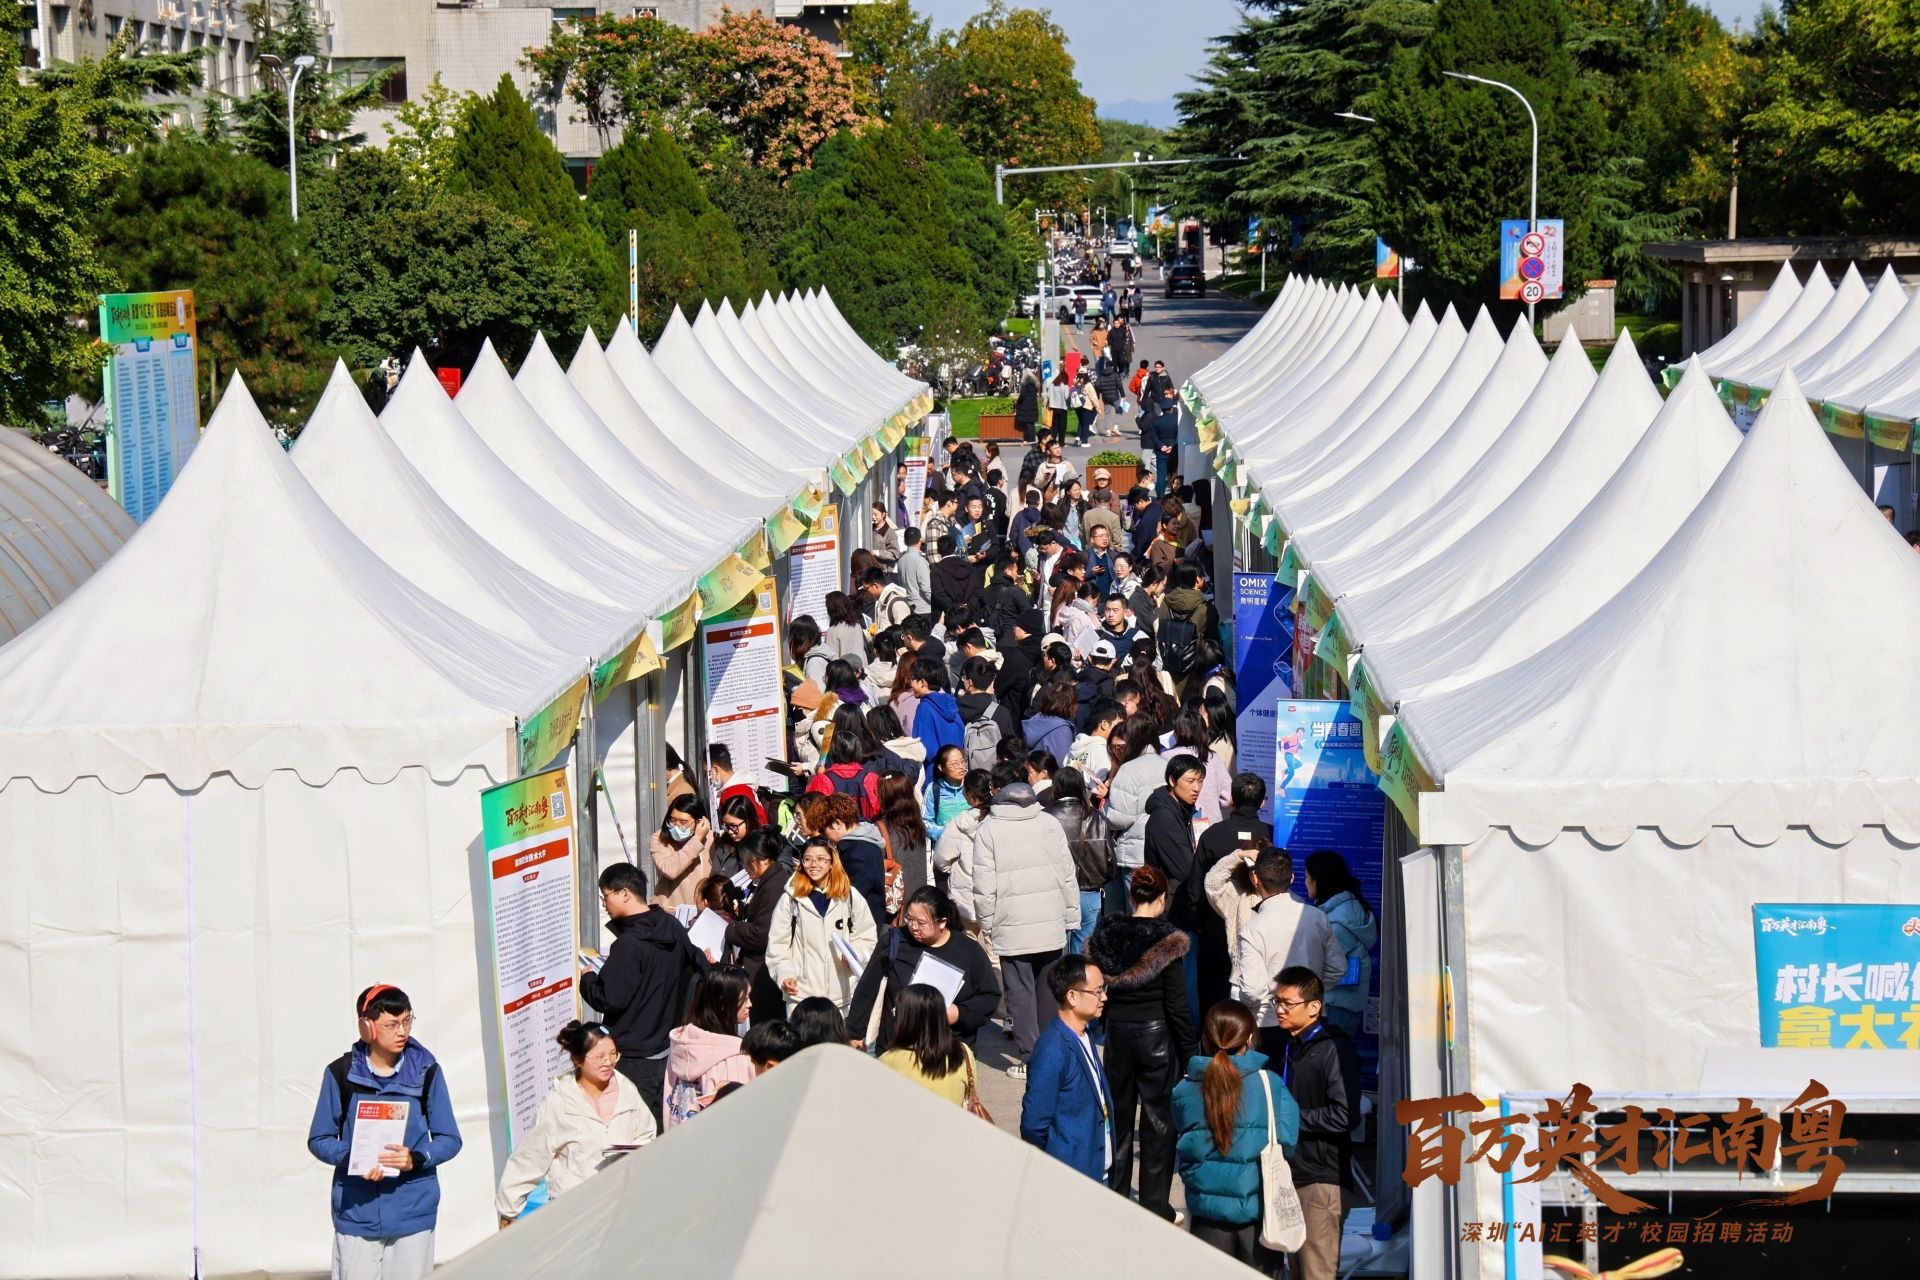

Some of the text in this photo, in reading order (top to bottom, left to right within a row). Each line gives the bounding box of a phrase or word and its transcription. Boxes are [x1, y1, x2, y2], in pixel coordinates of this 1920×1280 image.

[1526, 286, 1539, 297] 20
[1239, 577, 1267, 588] OMIX
[1239, 588, 1268, 596] SCIENCE
[505, 795, 549, 827] 百万英才汇南粤
[1760, 916, 1833, 937] 百万英才汇南粤
